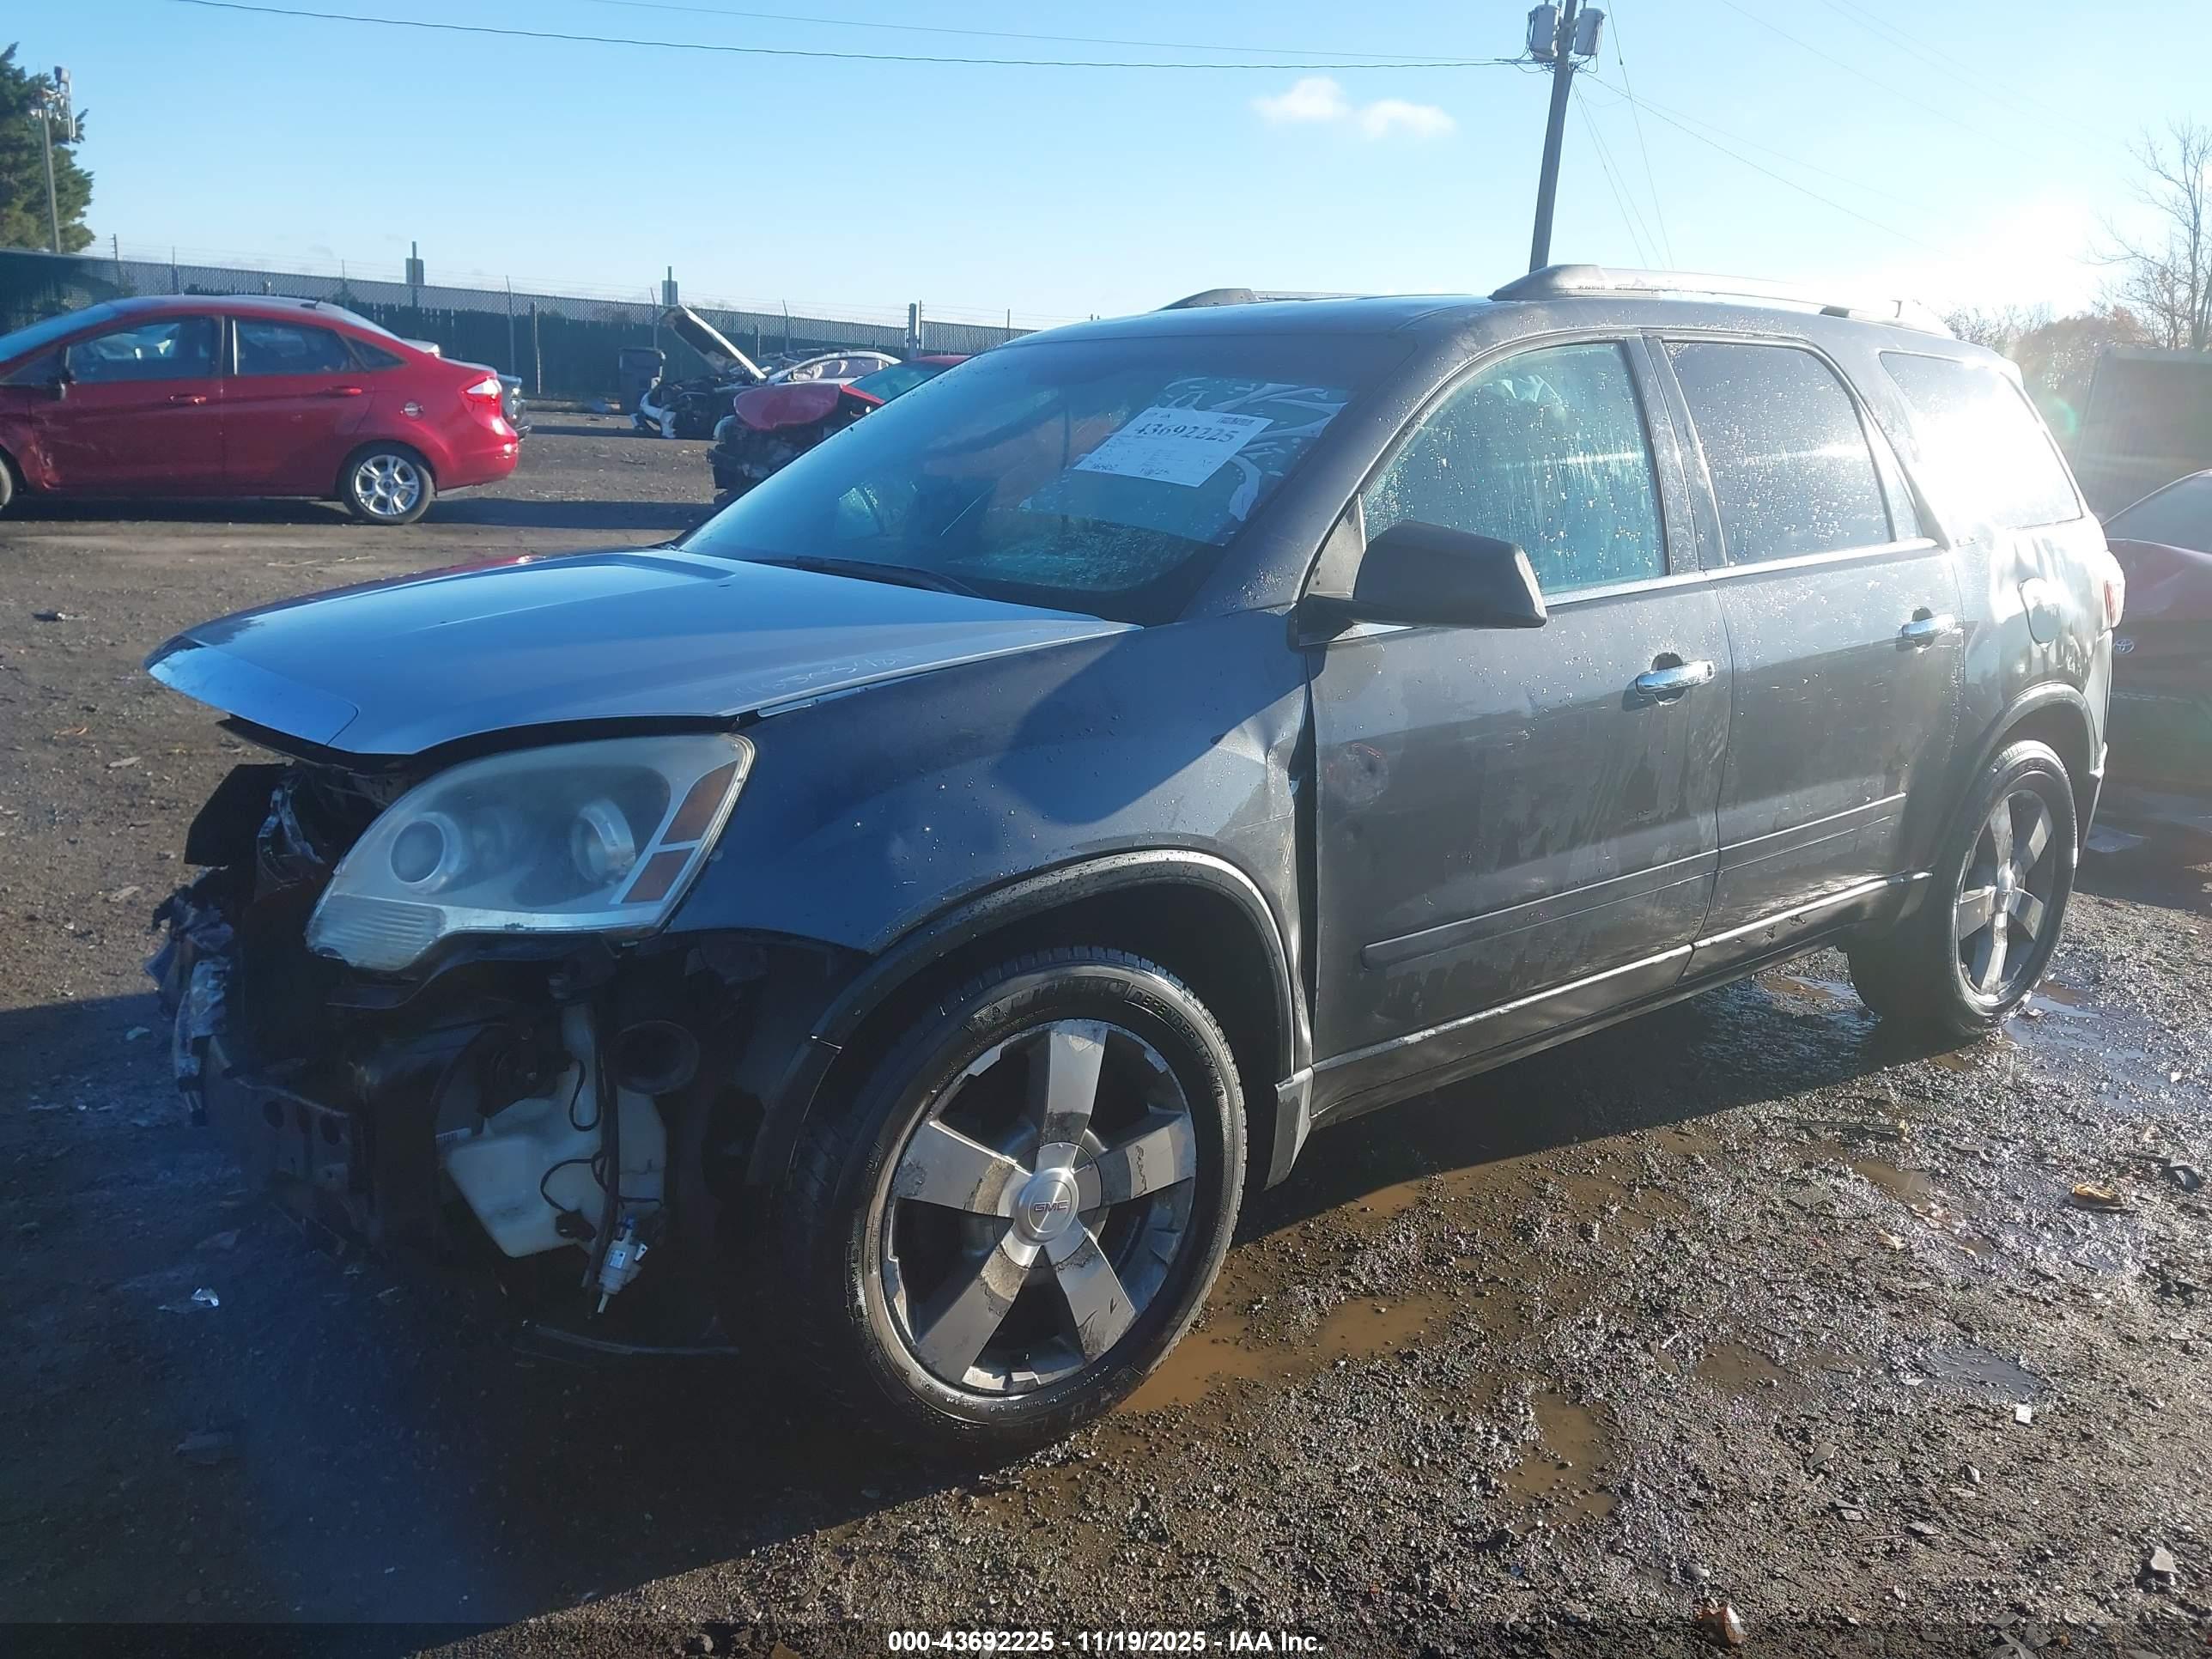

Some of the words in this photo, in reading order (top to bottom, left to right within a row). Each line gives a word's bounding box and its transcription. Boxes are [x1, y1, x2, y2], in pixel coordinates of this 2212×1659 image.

[1133, 422, 1239, 443] 43692225
[1130, 989, 1198, 1041] DEFENDER
[1033, 1200, 1070, 1213] GMC
